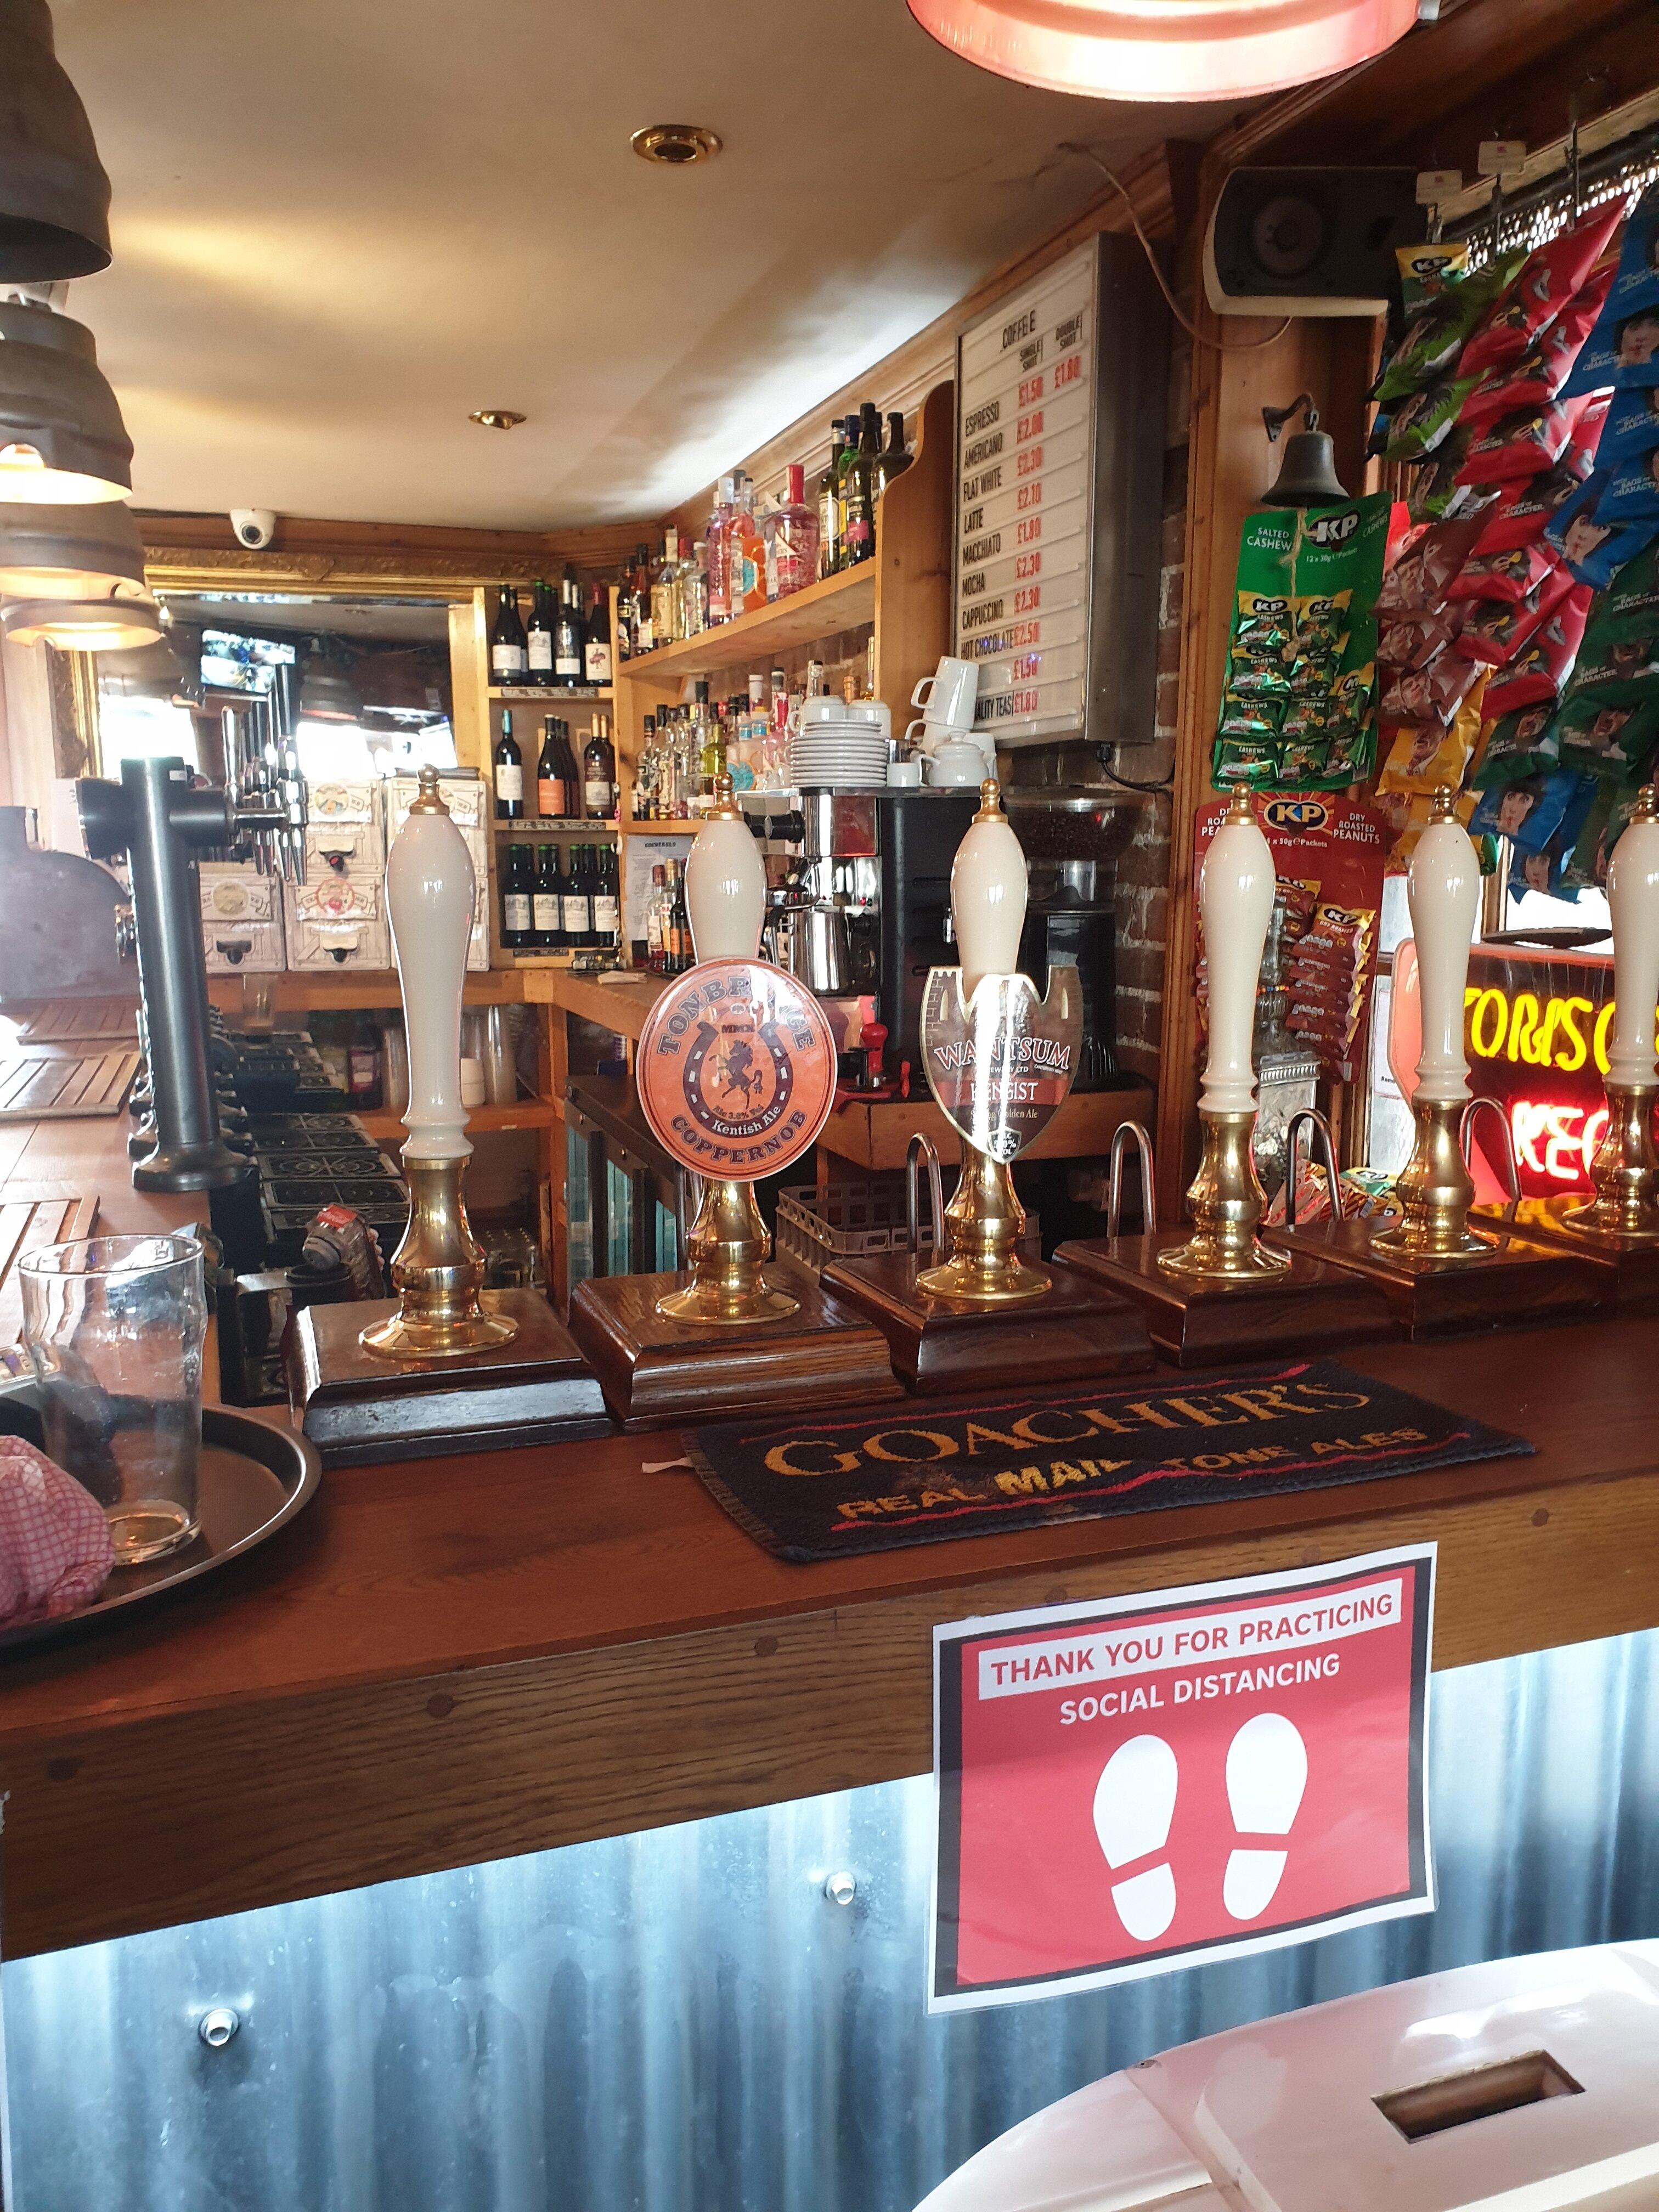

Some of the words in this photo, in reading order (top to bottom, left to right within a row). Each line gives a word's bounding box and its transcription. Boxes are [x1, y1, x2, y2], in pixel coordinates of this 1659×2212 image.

[1003, 309, 1036, 348] COFFEE
[965, 400, 1000, 437] ESPRESSO
[1054, 356, 1081, 388] £1.80
[964, 432, 1003, 470] AMERICANO
[963, 477, 980, 503] FLAT
[980, 466, 1002, 494] WHITE
[1017, 445, 1042, 477] £2.30
[964, 508, 984, 534] LATTE
[1017, 482, 1042, 510] £2.10
[1247, 535, 1293, 551] CASHEW
[1257, 527, 1289, 538] SALTED
[1316, 515, 1359, 543] KP
[963, 533, 1001, 566] MACCHIATO
[962, 572, 985, 597] MOCHA
[1016, 551, 1041, 579] £2.30
[962, 600, 1004, 630] CAPPUCCINO
[1014, 586, 1041, 614] £2.30
[1255, 600, 1284, 612] KP
[961, 639, 974, 660] HOT
[974, 628, 1014, 658] CHOCOLATE
[1014, 622, 1041, 647] £2.50
[975, 699, 995, 721] ALITY
[996, 696, 1012, 717] TEAS
[1014, 690, 1039, 714] £1.80
[1240, 701, 1268, 709] CASHEWS
[1239, 746, 1265, 754] CASHEWS
[1277, 805, 1322, 822] KP
[1350, 812, 1365, 822] DRY
[1339, 821, 1375, 833] ROASTED
[1279, 838, 1293, 847] 50g
[1301, 838, 1328, 848] Packets
[1333, 828, 1380, 844] PEANUTS
[1328, 910, 1357, 923] KP
[657, 975, 817, 1056] TONBRGE
[711, 1117, 763, 1136] Kentish
[765, 1105, 781, 1126] Ale
[997, 1108, 1024, 1119] olden
[1025, 1108, 1038, 1119] Ale
[670, 1109, 808, 1165] COPPERNOB
[764, 1383, 1370, 1477] GOACHER'S
[836, 1488, 987, 1519] REAL
[1310, 1427, 1429, 1455] ALES
[991, 1647, 1094, 1686] THANK
[1105, 1636, 1163, 1667] YOU
[1175, 1627, 1229, 1657] FOR
[1239, 1593, 1393, 1643] PRACTICING
[1060, 1684, 1165, 1726] SOCIAL
[1174, 1652, 1341, 1705] DISTANCING
